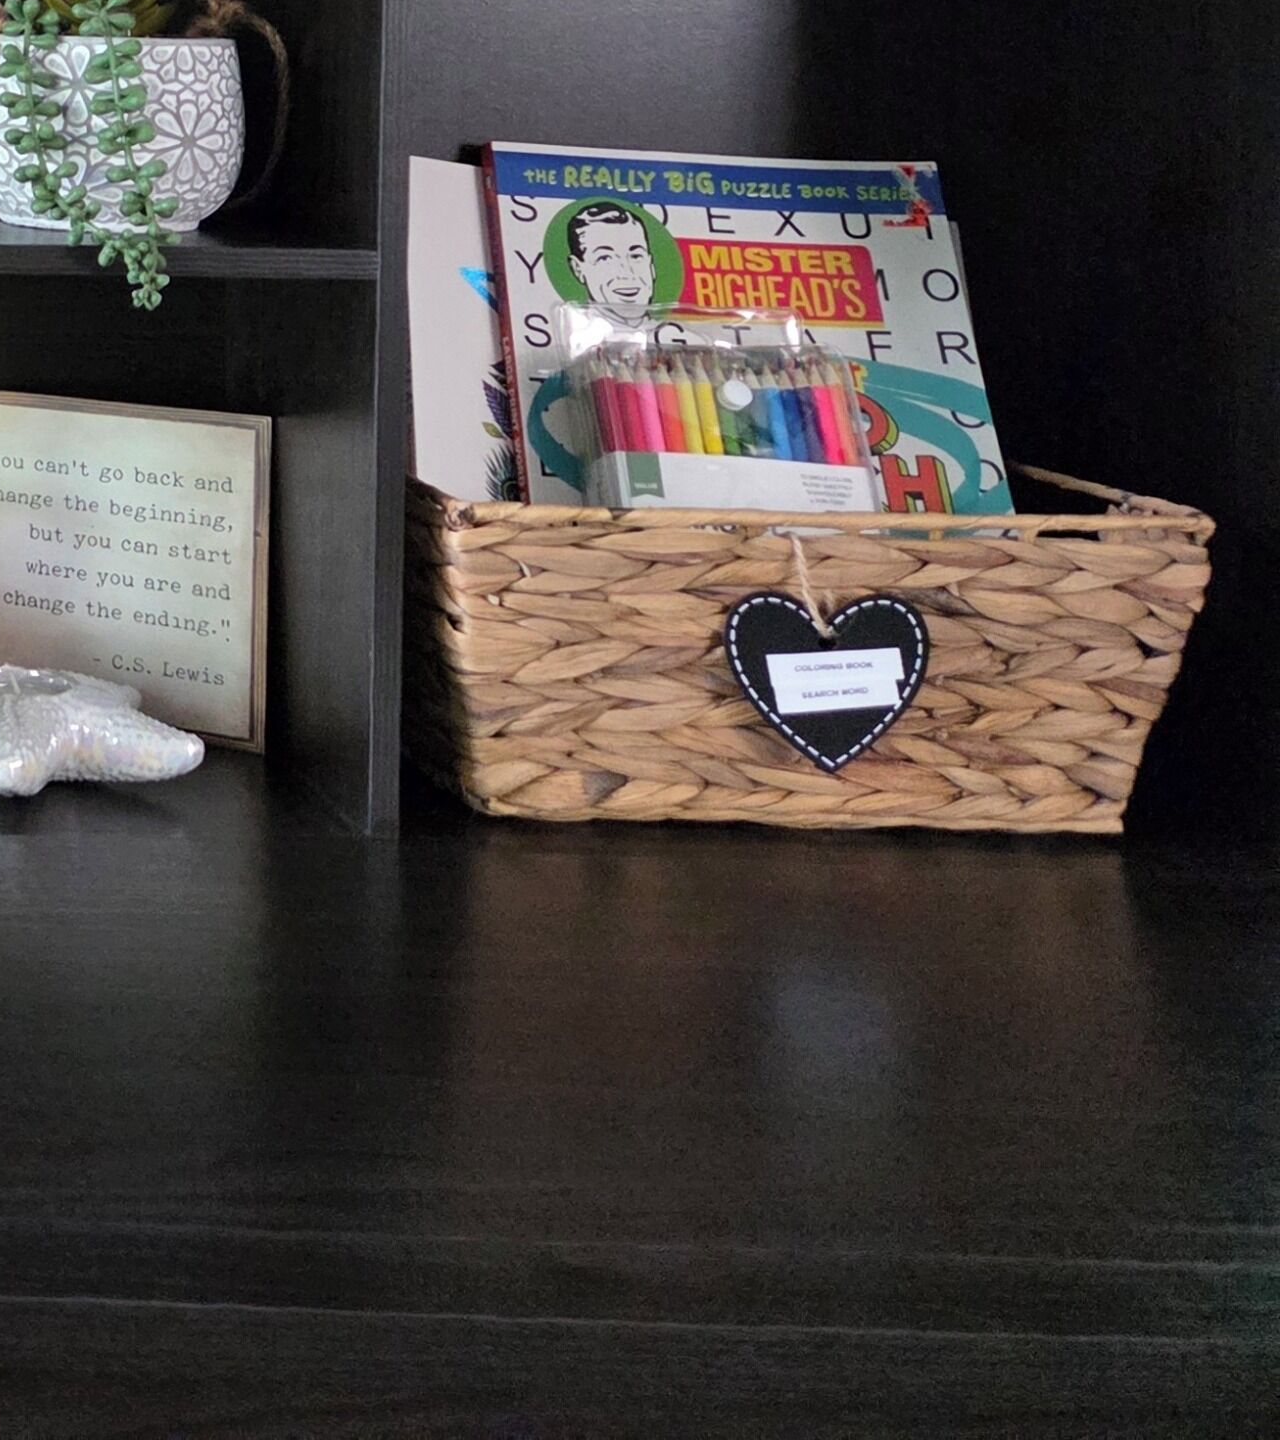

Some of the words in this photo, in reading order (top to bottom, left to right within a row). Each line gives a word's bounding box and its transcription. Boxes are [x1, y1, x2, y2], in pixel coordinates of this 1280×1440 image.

[563, 165, 655, 193] REALLY
[721, 180, 793, 200] PUZZLE
[796, 183, 850, 201] BOOK
[690, 244, 857, 276] MISTER
[693, 271, 867, 320] BIGHEAD'S
[34, 458, 90, 478] can't
[99, 466, 125, 484] go
[134, 466, 186, 488] back
[194, 477, 234, 494] and
[63, 494, 100, 513] the
[110, 499, 234, 534] beginning,
[29, 523, 65, 543] but
[74, 533, 112, 551] you
[121, 538, 159, 556] can
[168, 544, 233, 565] start
[25, 560, 88, 581] where
[97, 570, 135, 588] you
[143, 578, 182, 594] are
[191, 584, 231, 601] and
[3, 589, 77, 616] change
[85, 602, 123, 620] the
[111, 654, 152, 675] C.S.
[162, 661, 225, 686] Lewis
[794, 662, 844, 673] COLORING
[845, 661, 874, 670] BOOK
[801, 690, 839, 699] SEARCH
[841, 686, 870, 696] WORD
